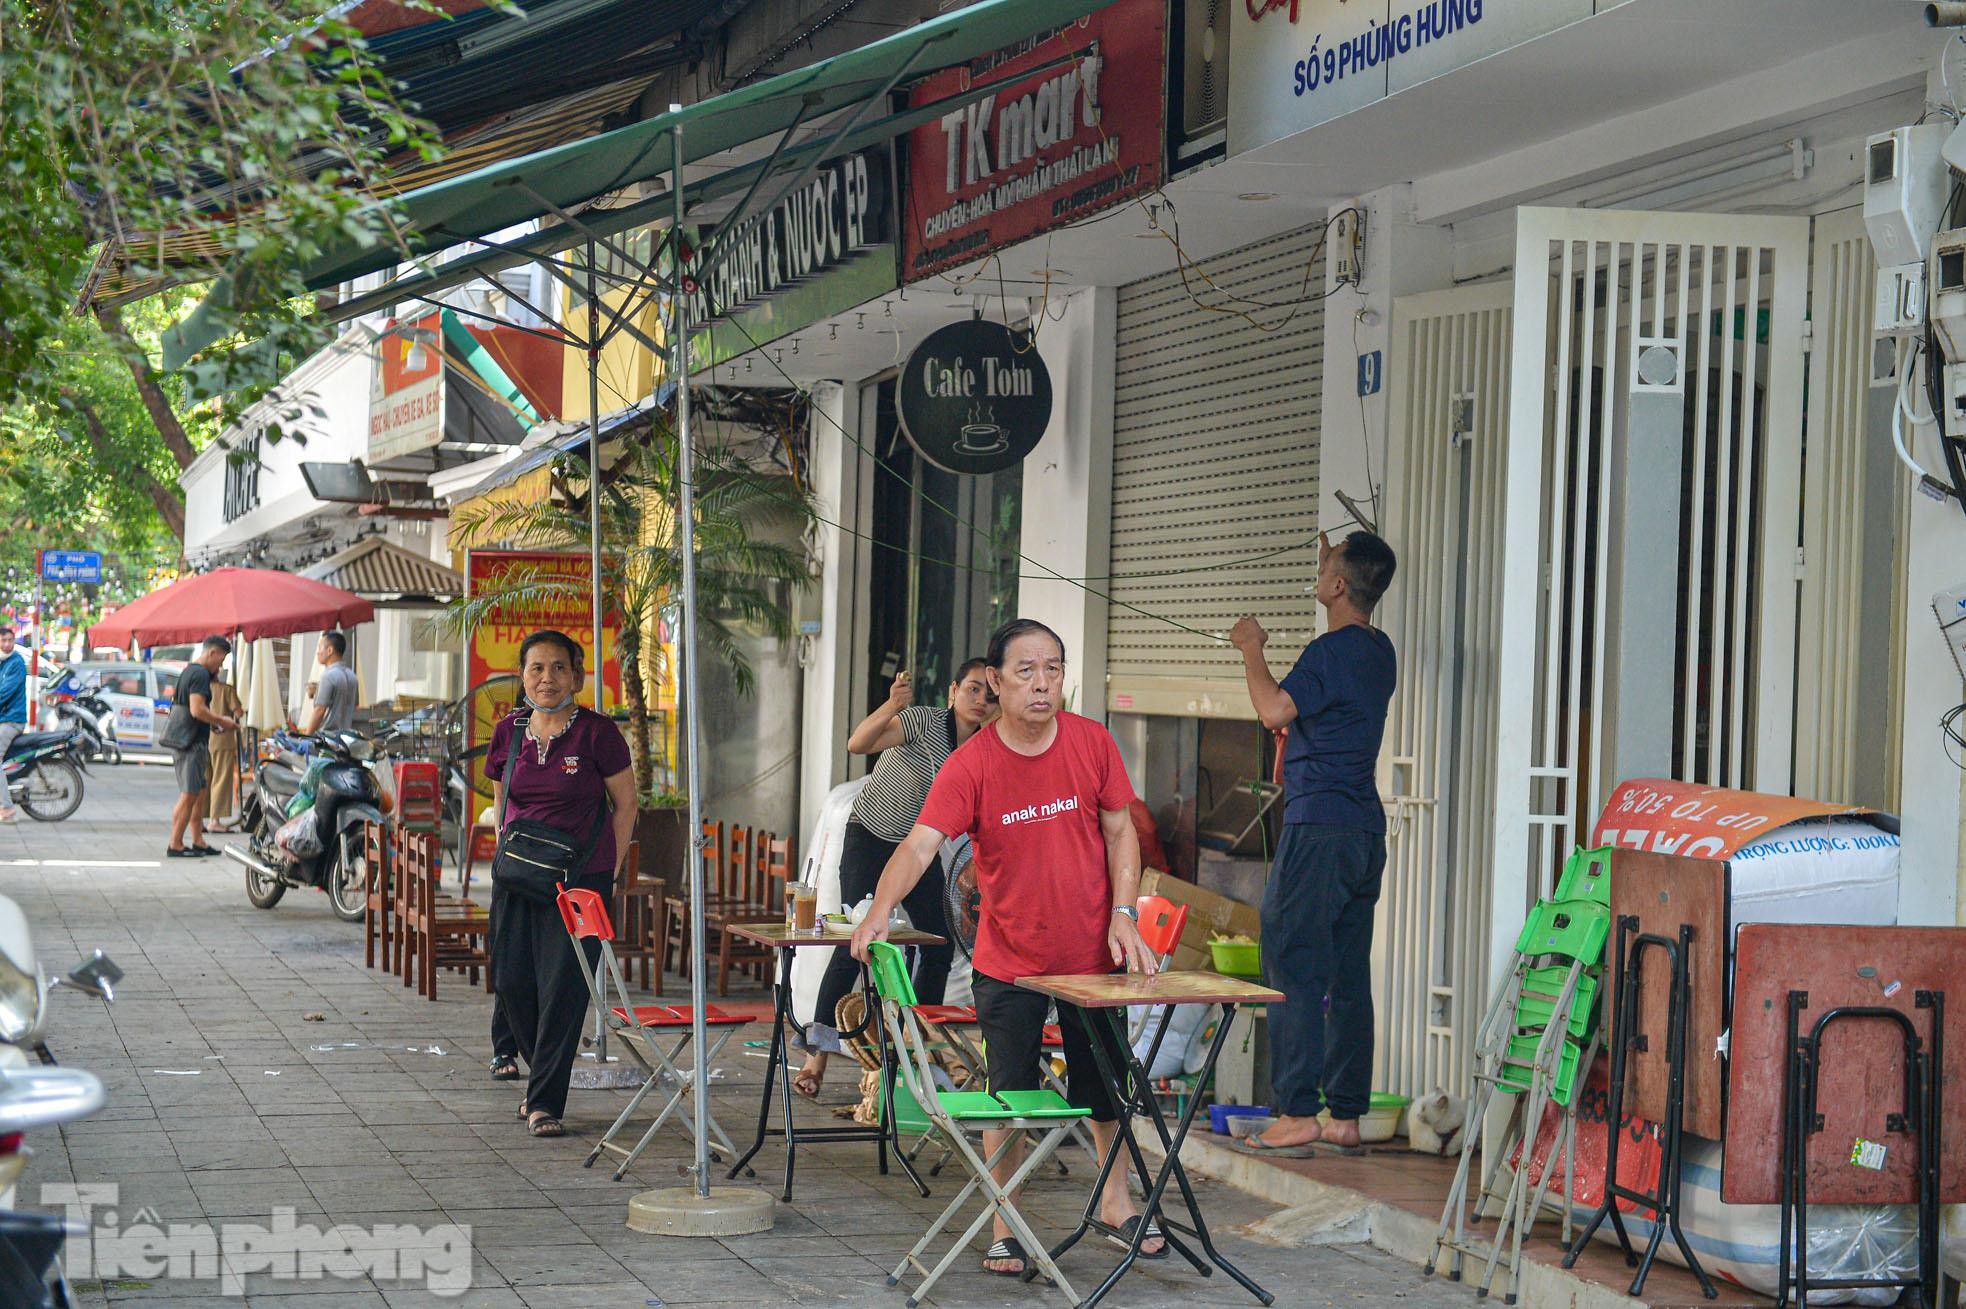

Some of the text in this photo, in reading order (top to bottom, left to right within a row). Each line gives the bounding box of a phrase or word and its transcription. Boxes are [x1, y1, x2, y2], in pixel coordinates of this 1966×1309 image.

[1294, 33, 1321, 96] SỐ
[1323, 49, 1335, 84] 9
[1338, 14, 1411, 80] PHÙNG
[941, 95, 997, 194] TK
[998, 40, 1103, 170] mart
[1083, 135, 1119, 171] LAN
[767, 210, 781, 290] &
[923, 356, 1032, 397] Cafe Tom
[1365, 353, 1375, 394] 9
[1002, 804, 1038, 825] anak
[1041, 795, 1078, 816] nakal
[1616, 788, 1674, 814] 50%
[1670, 800, 1718, 822] TO
[1716, 812, 1768, 831] UP
